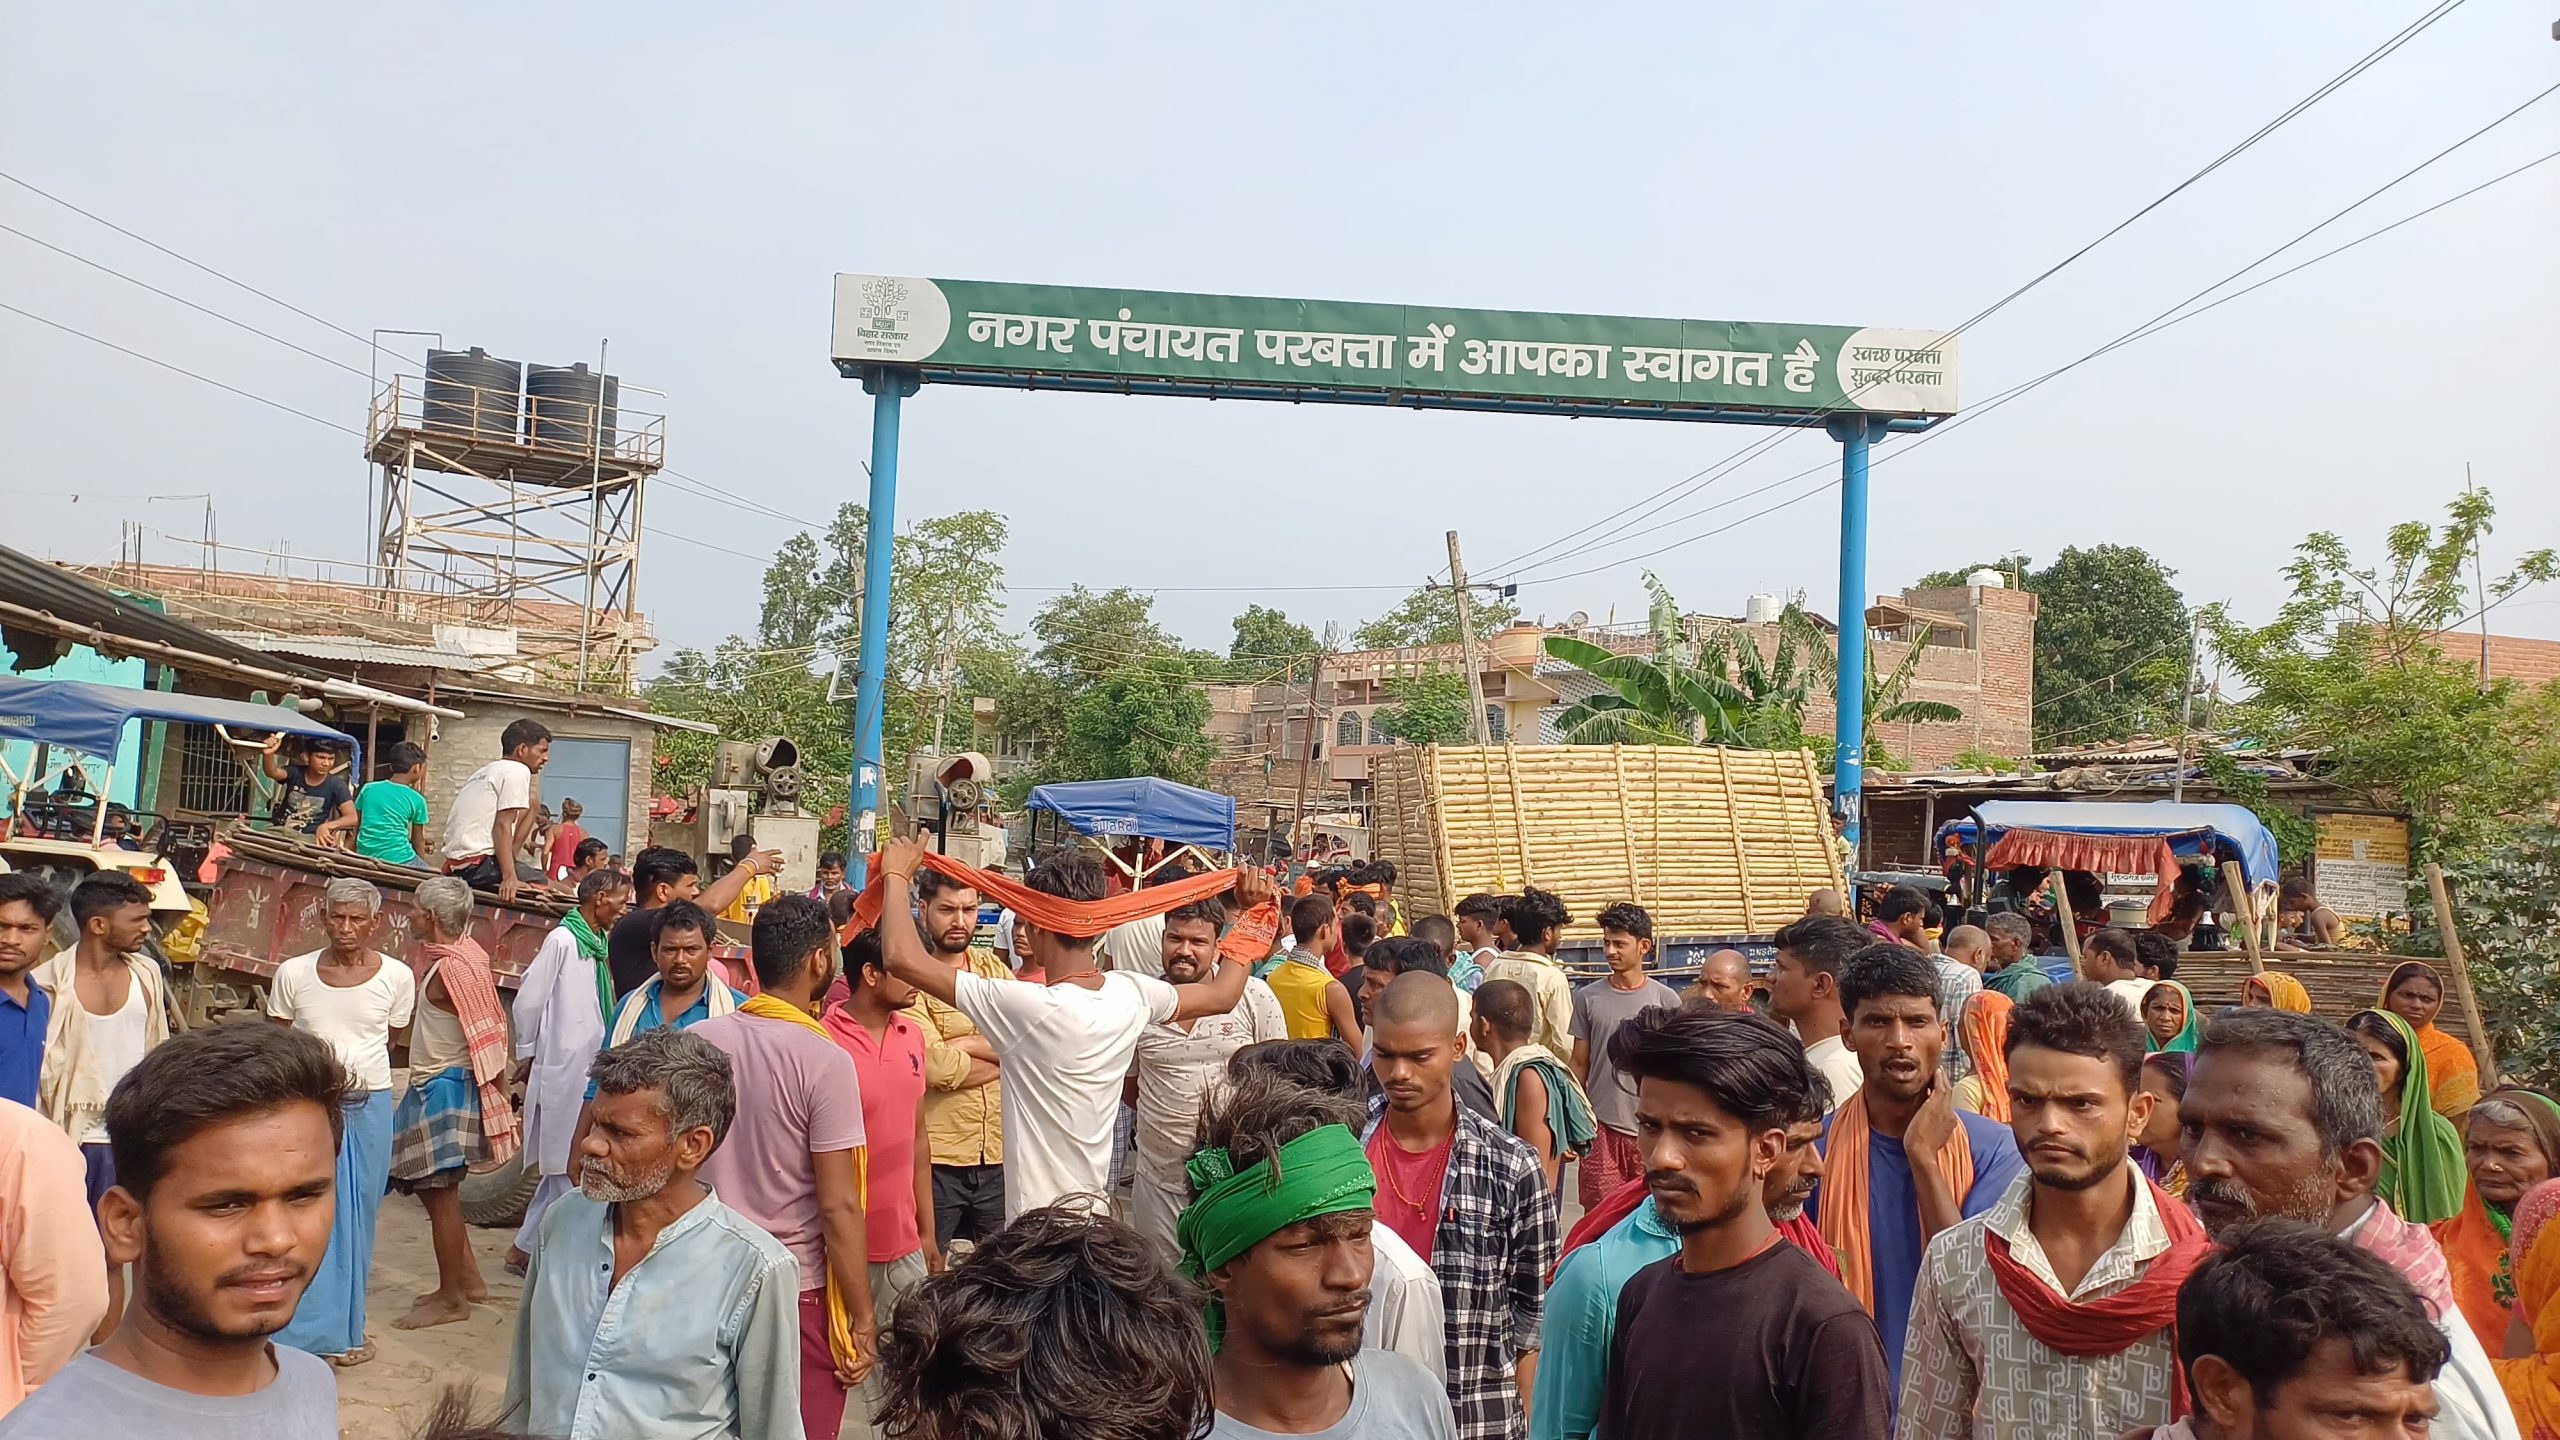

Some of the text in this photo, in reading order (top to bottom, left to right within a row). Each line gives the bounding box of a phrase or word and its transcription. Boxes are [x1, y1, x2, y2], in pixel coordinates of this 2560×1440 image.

[881, 332, 908, 340] सरकार
[967, 308, 1820, 393] नगर पंचायत परबत्ता में आपका स्वागत है
[1852, 346, 1942, 365] स्वच्छ परबत्ता
[1850, 367, 1944, 388] सुन्दर परबत्ता
